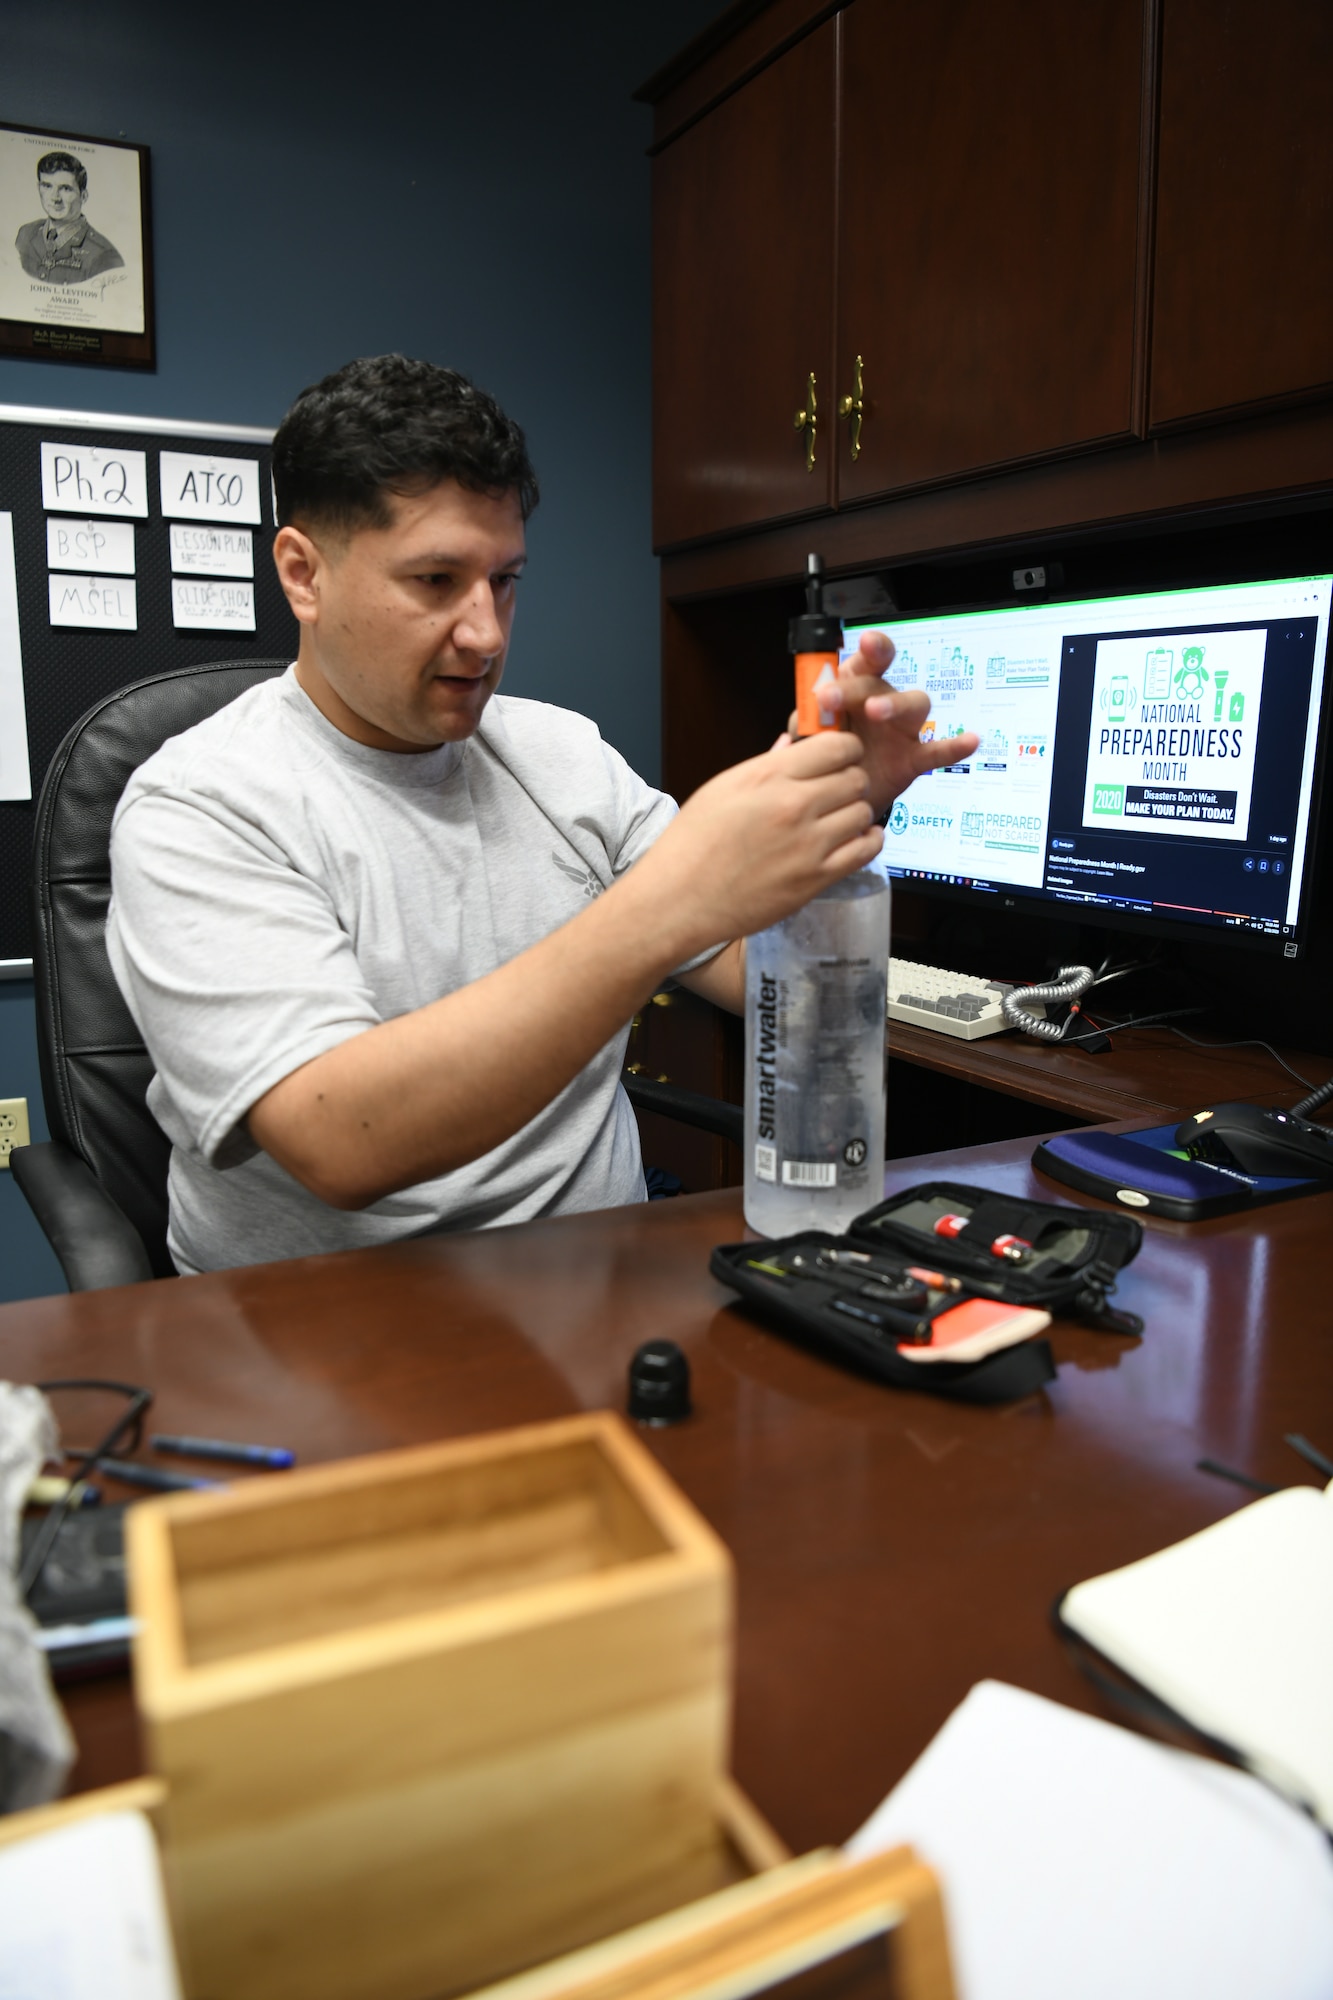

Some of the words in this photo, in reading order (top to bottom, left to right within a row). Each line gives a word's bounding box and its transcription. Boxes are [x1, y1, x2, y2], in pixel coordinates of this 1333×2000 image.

[30, 284, 52, 294] JOHN
[54, 287, 60, 295] L.
[62, 287, 98, 299] LEVITOW
[50, 296, 80, 305] AWARD
[179, 470, 244, 507] ATSO
[57, 529, 107, 560] BSP
[174, 530, 222, 552] LESSON
[224, 534, 251, 554] PLAN
[58, 587, 130, 618] MSEL
[177, 585, 215, 606] SLIDE
[940, 667, 961, 678] NATIONAL
[926, 678, 974, 692] PREPAREDNESS
[940, 692, 957, 701] MONTH
[1140, 703, 1202, 723] NATIONAL
[1099, 729, 1243, 759] PREPAREDNESS
[1142, 761, 1188, 781] MONTH
[1095, 789, 1122, 810] 2020
[1143, 789, 1177, 801] Disasters
[1177, 792, 1198, 803] Don't
[1198, 793, 1218, 804] Wait.
[912, 801, 953, 816] NATIONAL
[1126, 802, 1151, 815] MAKE
[1151, 803, 1176, 816] YOUR
[1176, 805, 1201, 818] PLAN
[1201, 806, 1234, 821] TODAY.
[911, 815, 954, 829] SAFETY
[986, 813, 1042, 831] PREPARED
[911, 828, 951, 840] MONTH
[984, 828, 1004, 840] NOT
[1004, 830, 1042, 844] SCARED
[1049, 854, 1069, 863] National
[1068, 856, 1100, 867] Preparedness
[1100, 860, 1116, 869] Month
[1119, 862, 1146, 874] Ready.gov
[756, 971, 777, 1141] smartwater
